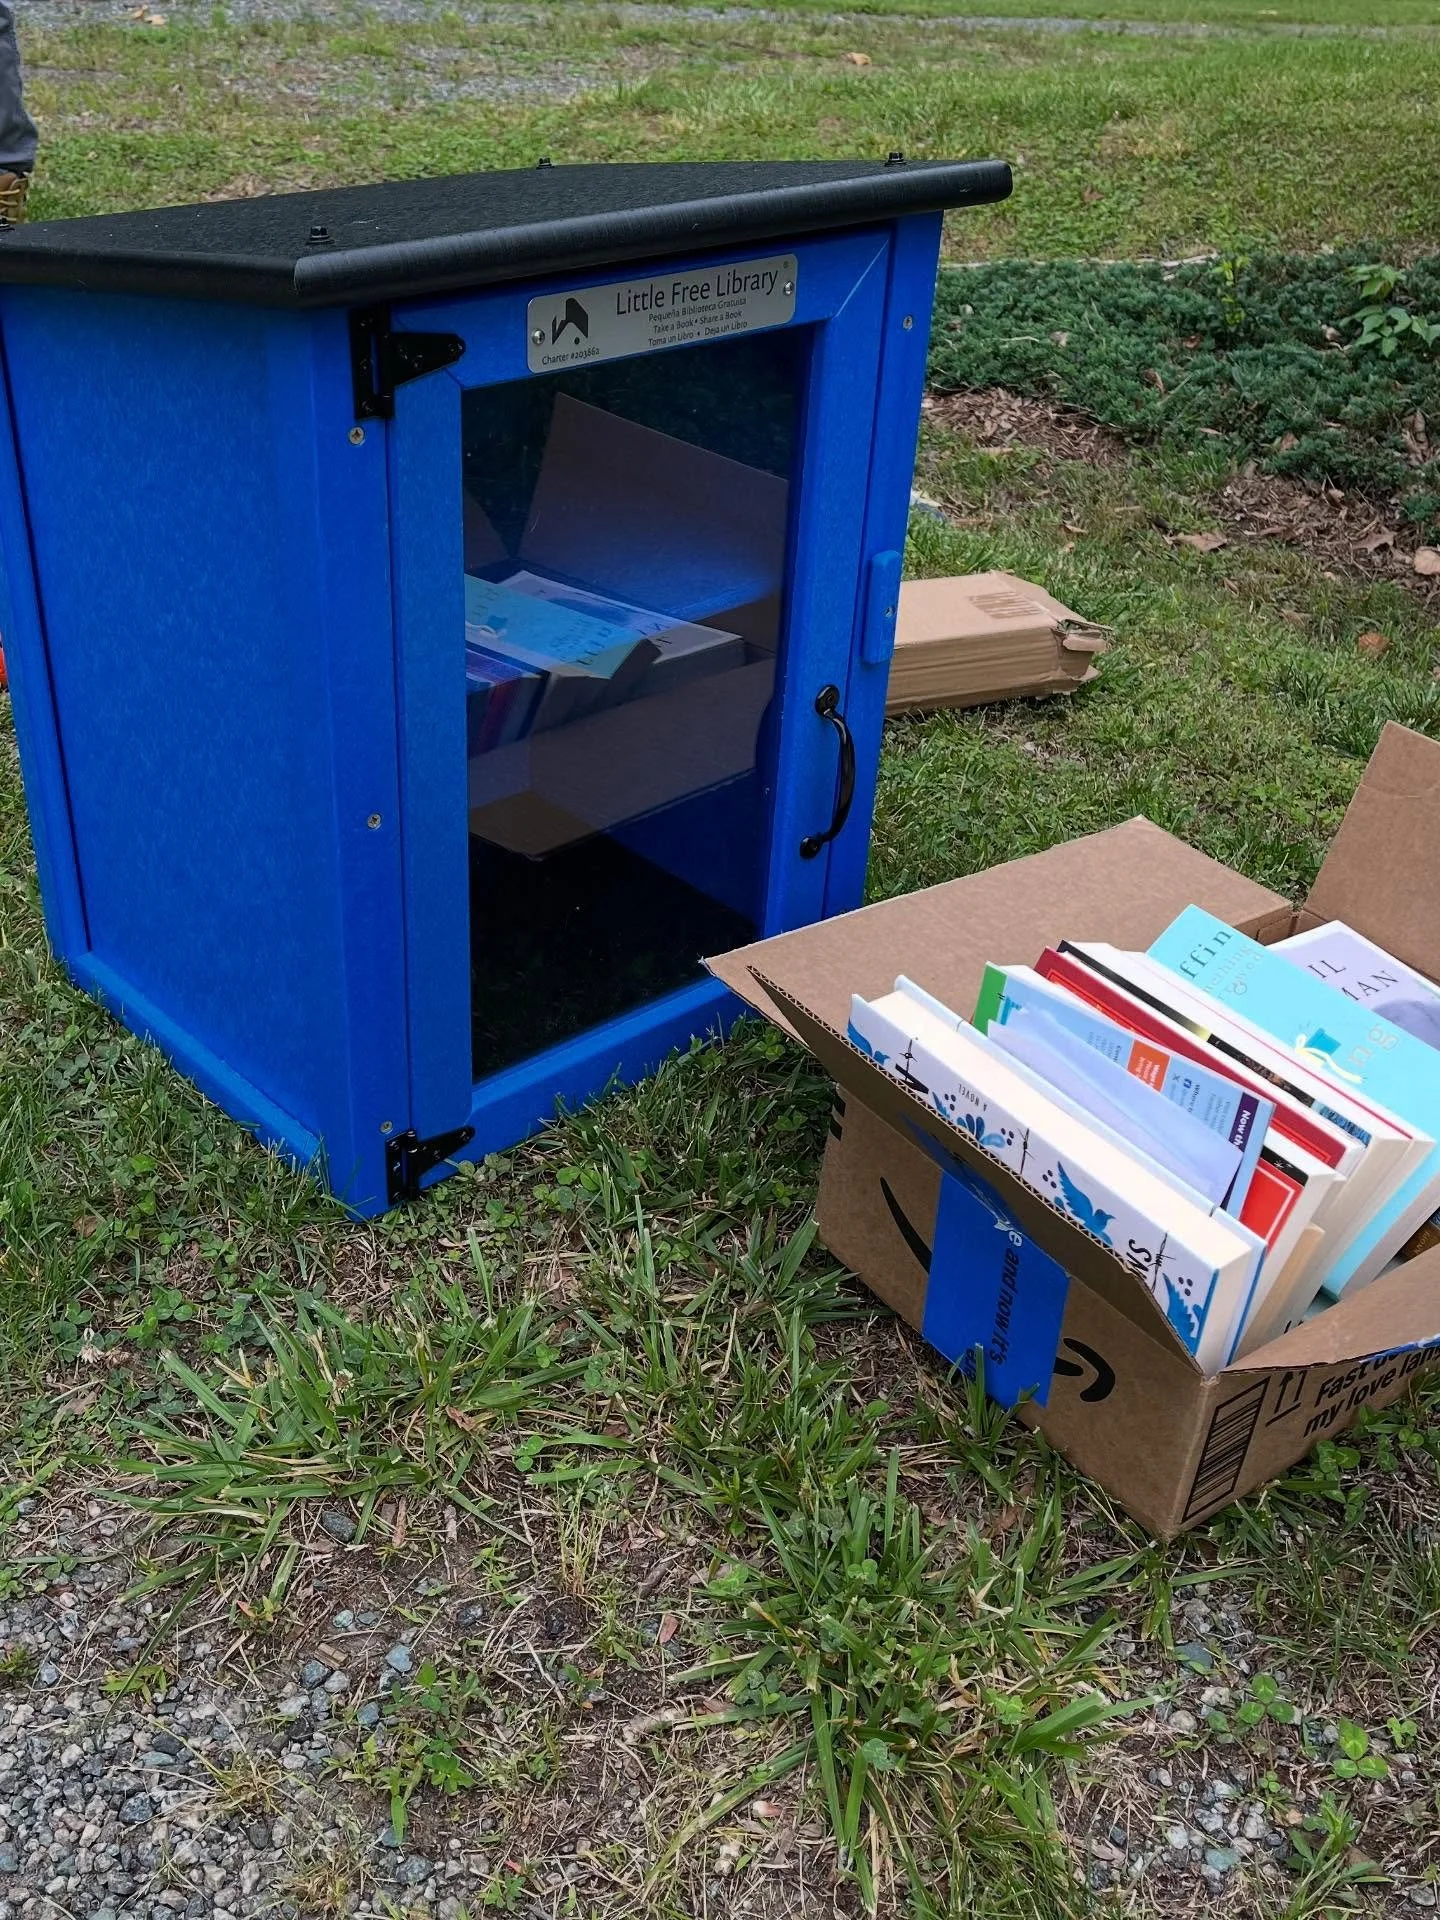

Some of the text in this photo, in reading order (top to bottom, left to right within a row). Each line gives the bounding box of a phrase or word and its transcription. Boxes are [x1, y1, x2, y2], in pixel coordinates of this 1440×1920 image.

[616, 269, 779, 316] Little Free Library
[648, 298, 747, 323] Pequeña Biblioteca Gratuita
[653, 324, 669, 334] Take
[676, 319, 694, 330] Book
[699, 315, 719, 325] Share
[725, 310, 742, 320] Book
[648, 321, 748, 346] Toma un Libro Deja un Libro
[541, 353, 569, 365] Charter
[1179, 930, 1233, 979] ffin
[1308, 960, 1346, 979] IL
[958, 1083, 980, 1107] NOVEL
[1237, 1110, 1251, 1134] Now
[1001, 1247, 1020, 1294] and
[994, 1289, 1014, 1335] now
[1314, 1361, 1368, 1408] Fast
[1303, 1399, 1346, 1438] my
[1345, 1367, 1397, 1412] love
